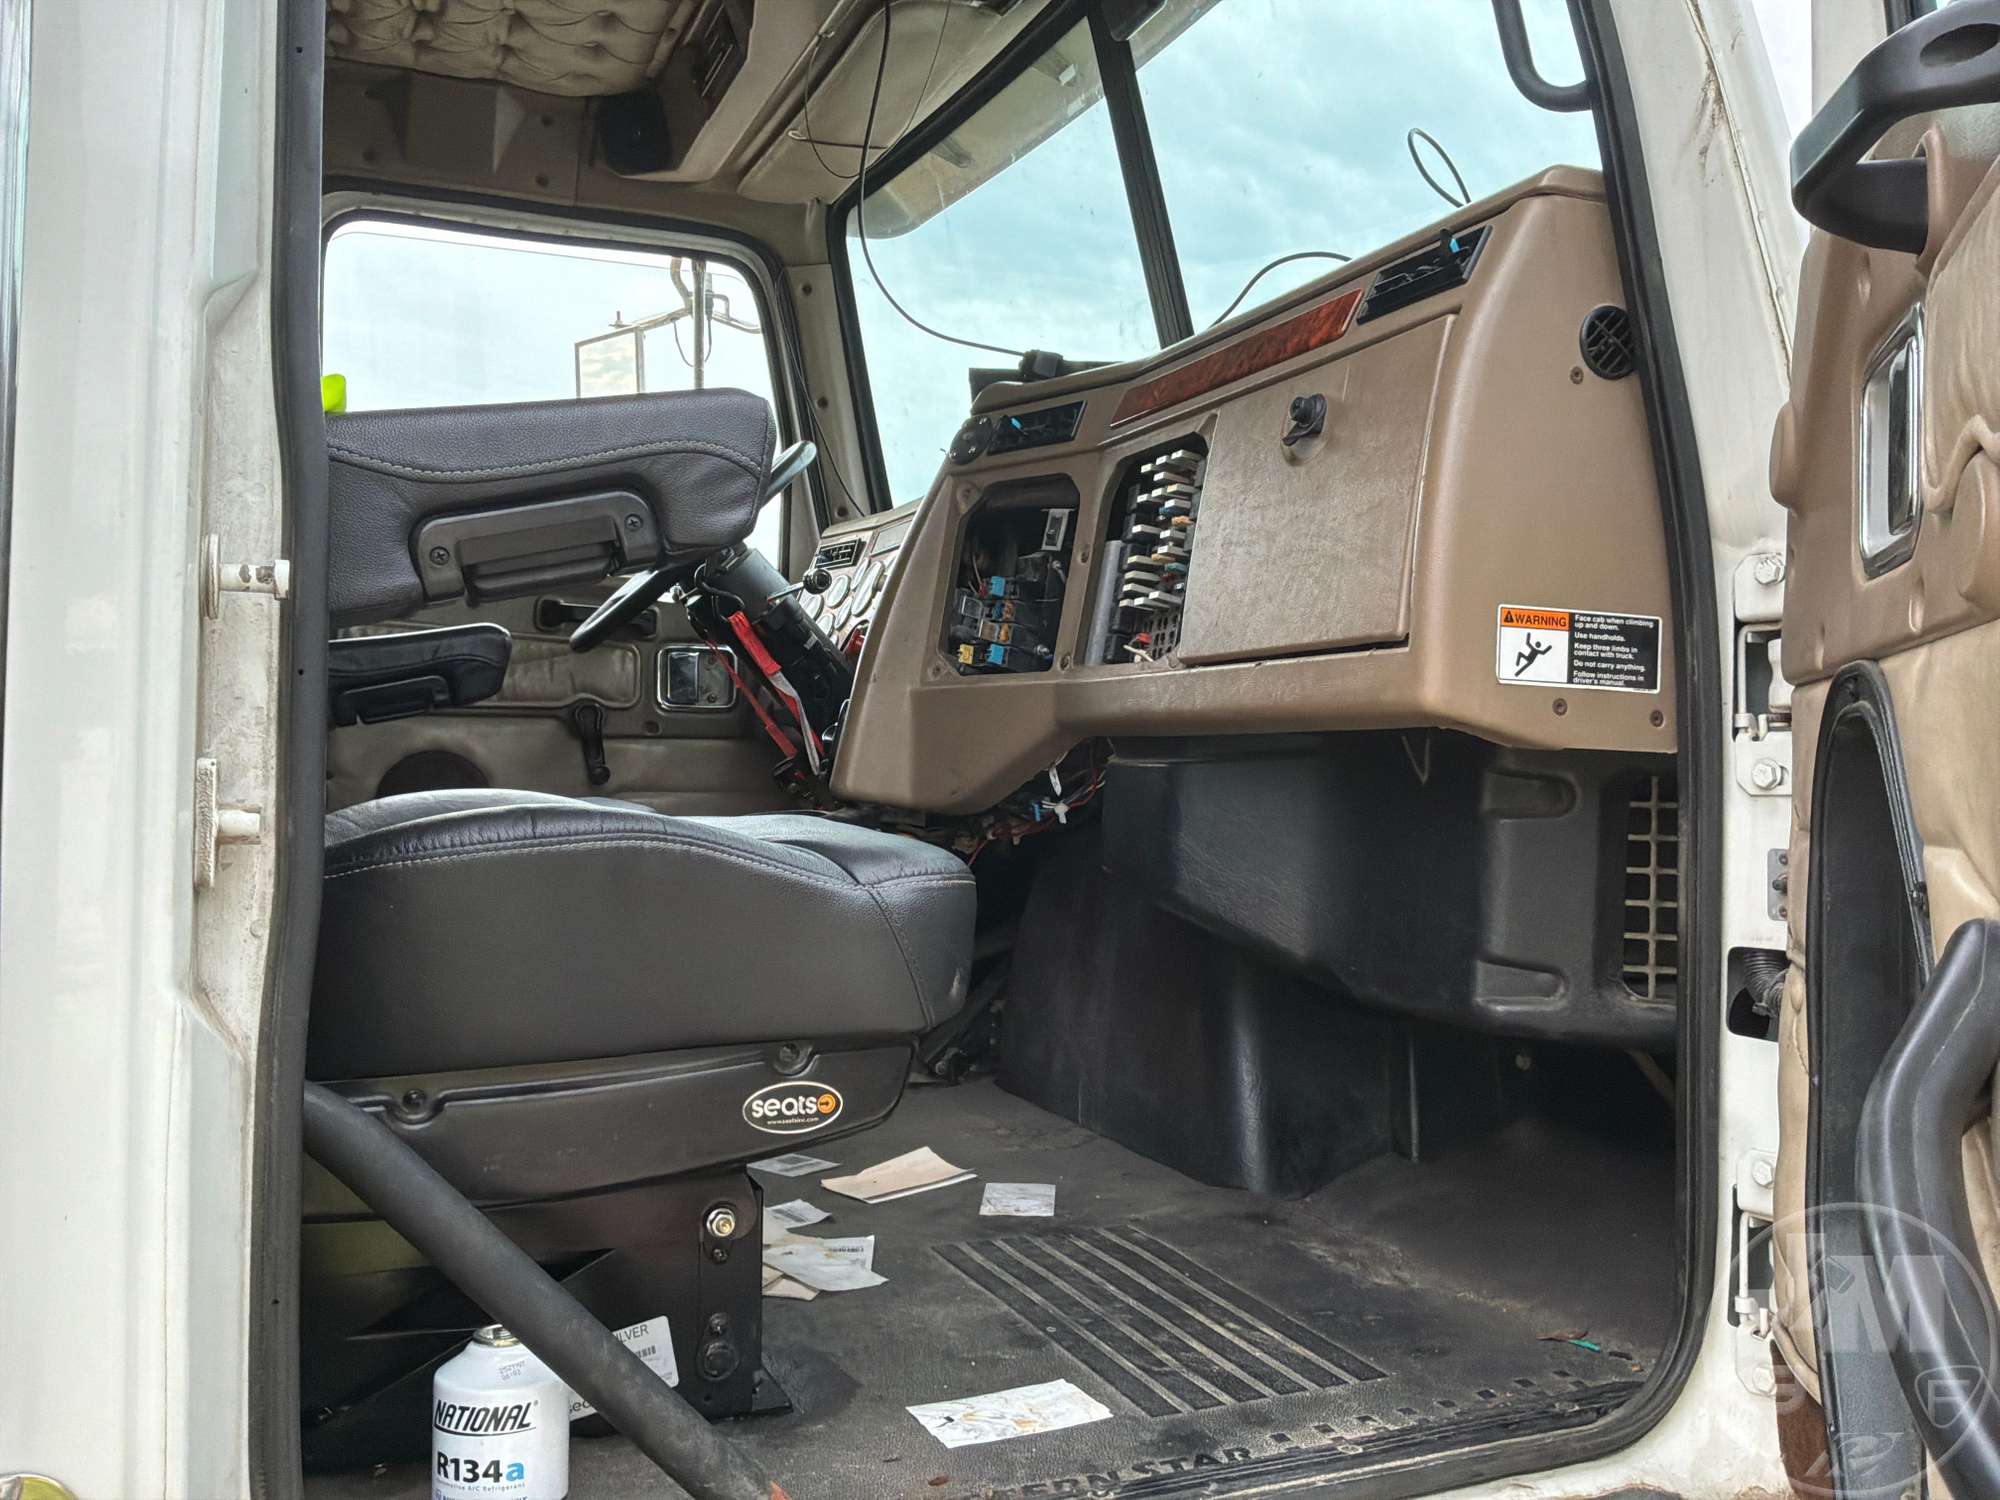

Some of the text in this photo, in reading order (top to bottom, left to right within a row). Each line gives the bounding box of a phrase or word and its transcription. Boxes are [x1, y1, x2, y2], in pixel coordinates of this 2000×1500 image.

[1514, 614, 1567, 628] WARNING
[1574, 614, 1591, 622] Face
[1625, 619, 1654, 628] climbing
[1574, 631, 1626, 642] Use handholds.
[1573, 649, 1599, 657] contact
[1615, 652, 1635, 660] truck.
[1574, 642, 1592, 650] Keep
[1592, 643, 1611, 651] three
[1611, 645, 1630, 653] limbs
[1573, 659, 1646, 673] Do not carry anything.
[1572, 676, 1598, 684] driver's
[1573, 670, 1596, 678] Follow
[1596, 671, 1637, 681] instructions
[751, 1095, 818, 1118] seats
[434, 1399, 533, 1433] NATIONAL
[437, 1450, 525, 1484] R134a
[1131, 1446, 1251, 1477] STAR
